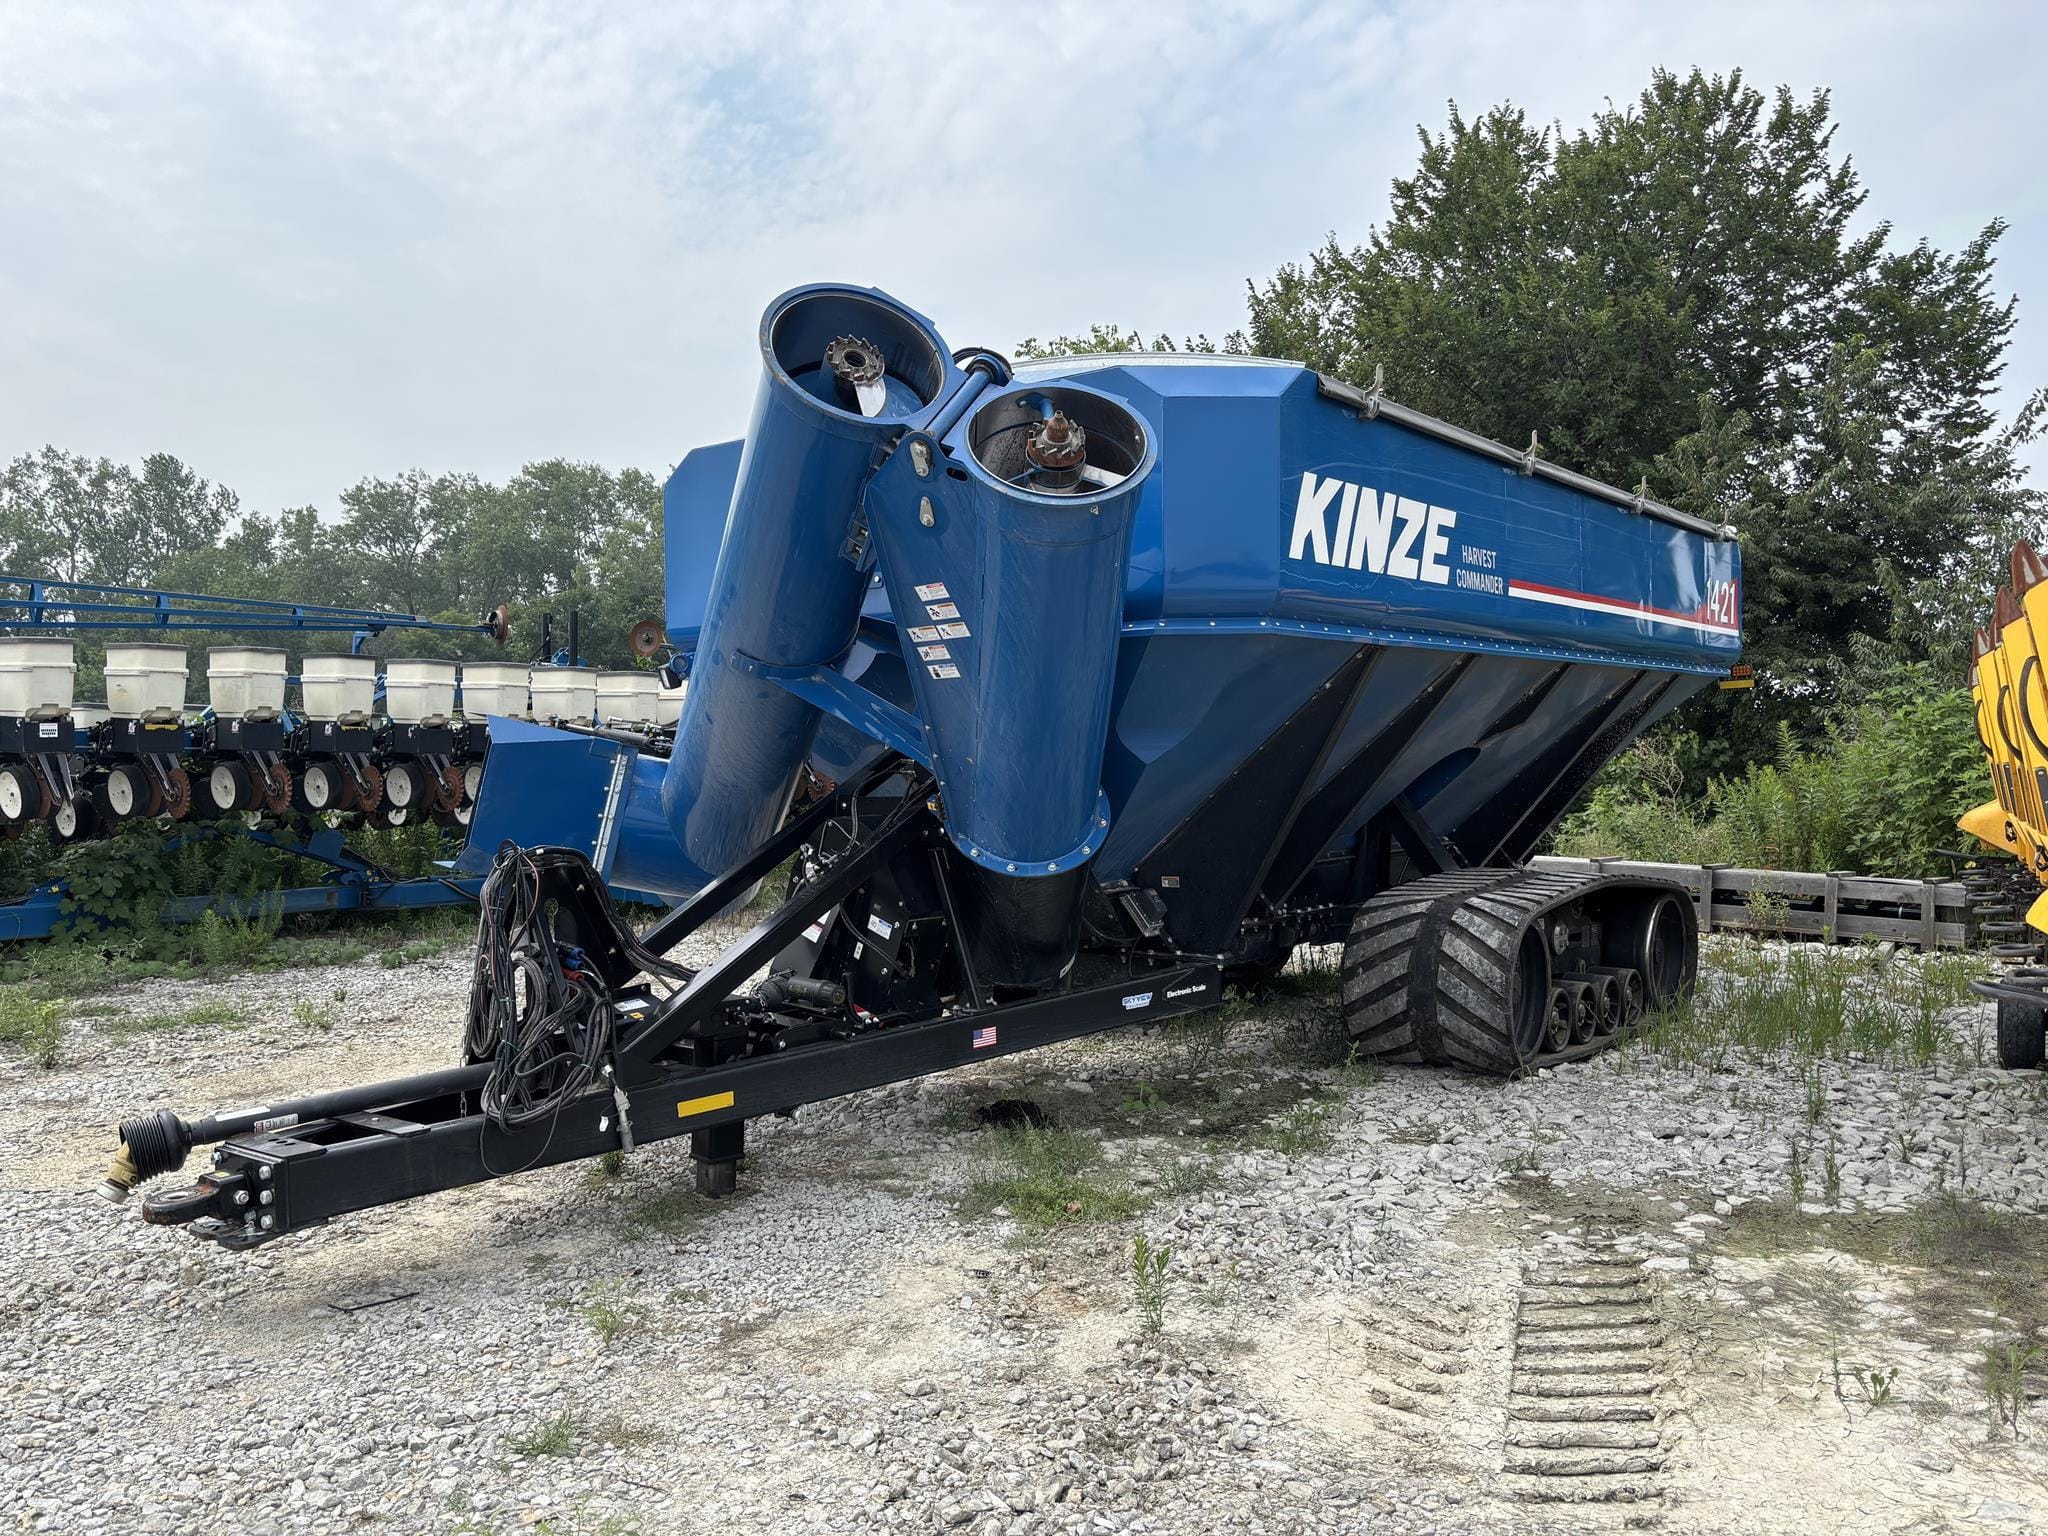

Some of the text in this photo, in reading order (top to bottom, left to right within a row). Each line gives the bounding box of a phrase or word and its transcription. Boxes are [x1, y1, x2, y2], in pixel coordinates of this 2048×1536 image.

[1289, 472, 1457, 585] KINZE
[1462, 544, 1496, 569] HARVEST
[1456, 569, 1503, 595] COMMANDER
[1707, 577, 1735, 624] 1421
[1166, 984, 1206, 998] Electronic Scale
